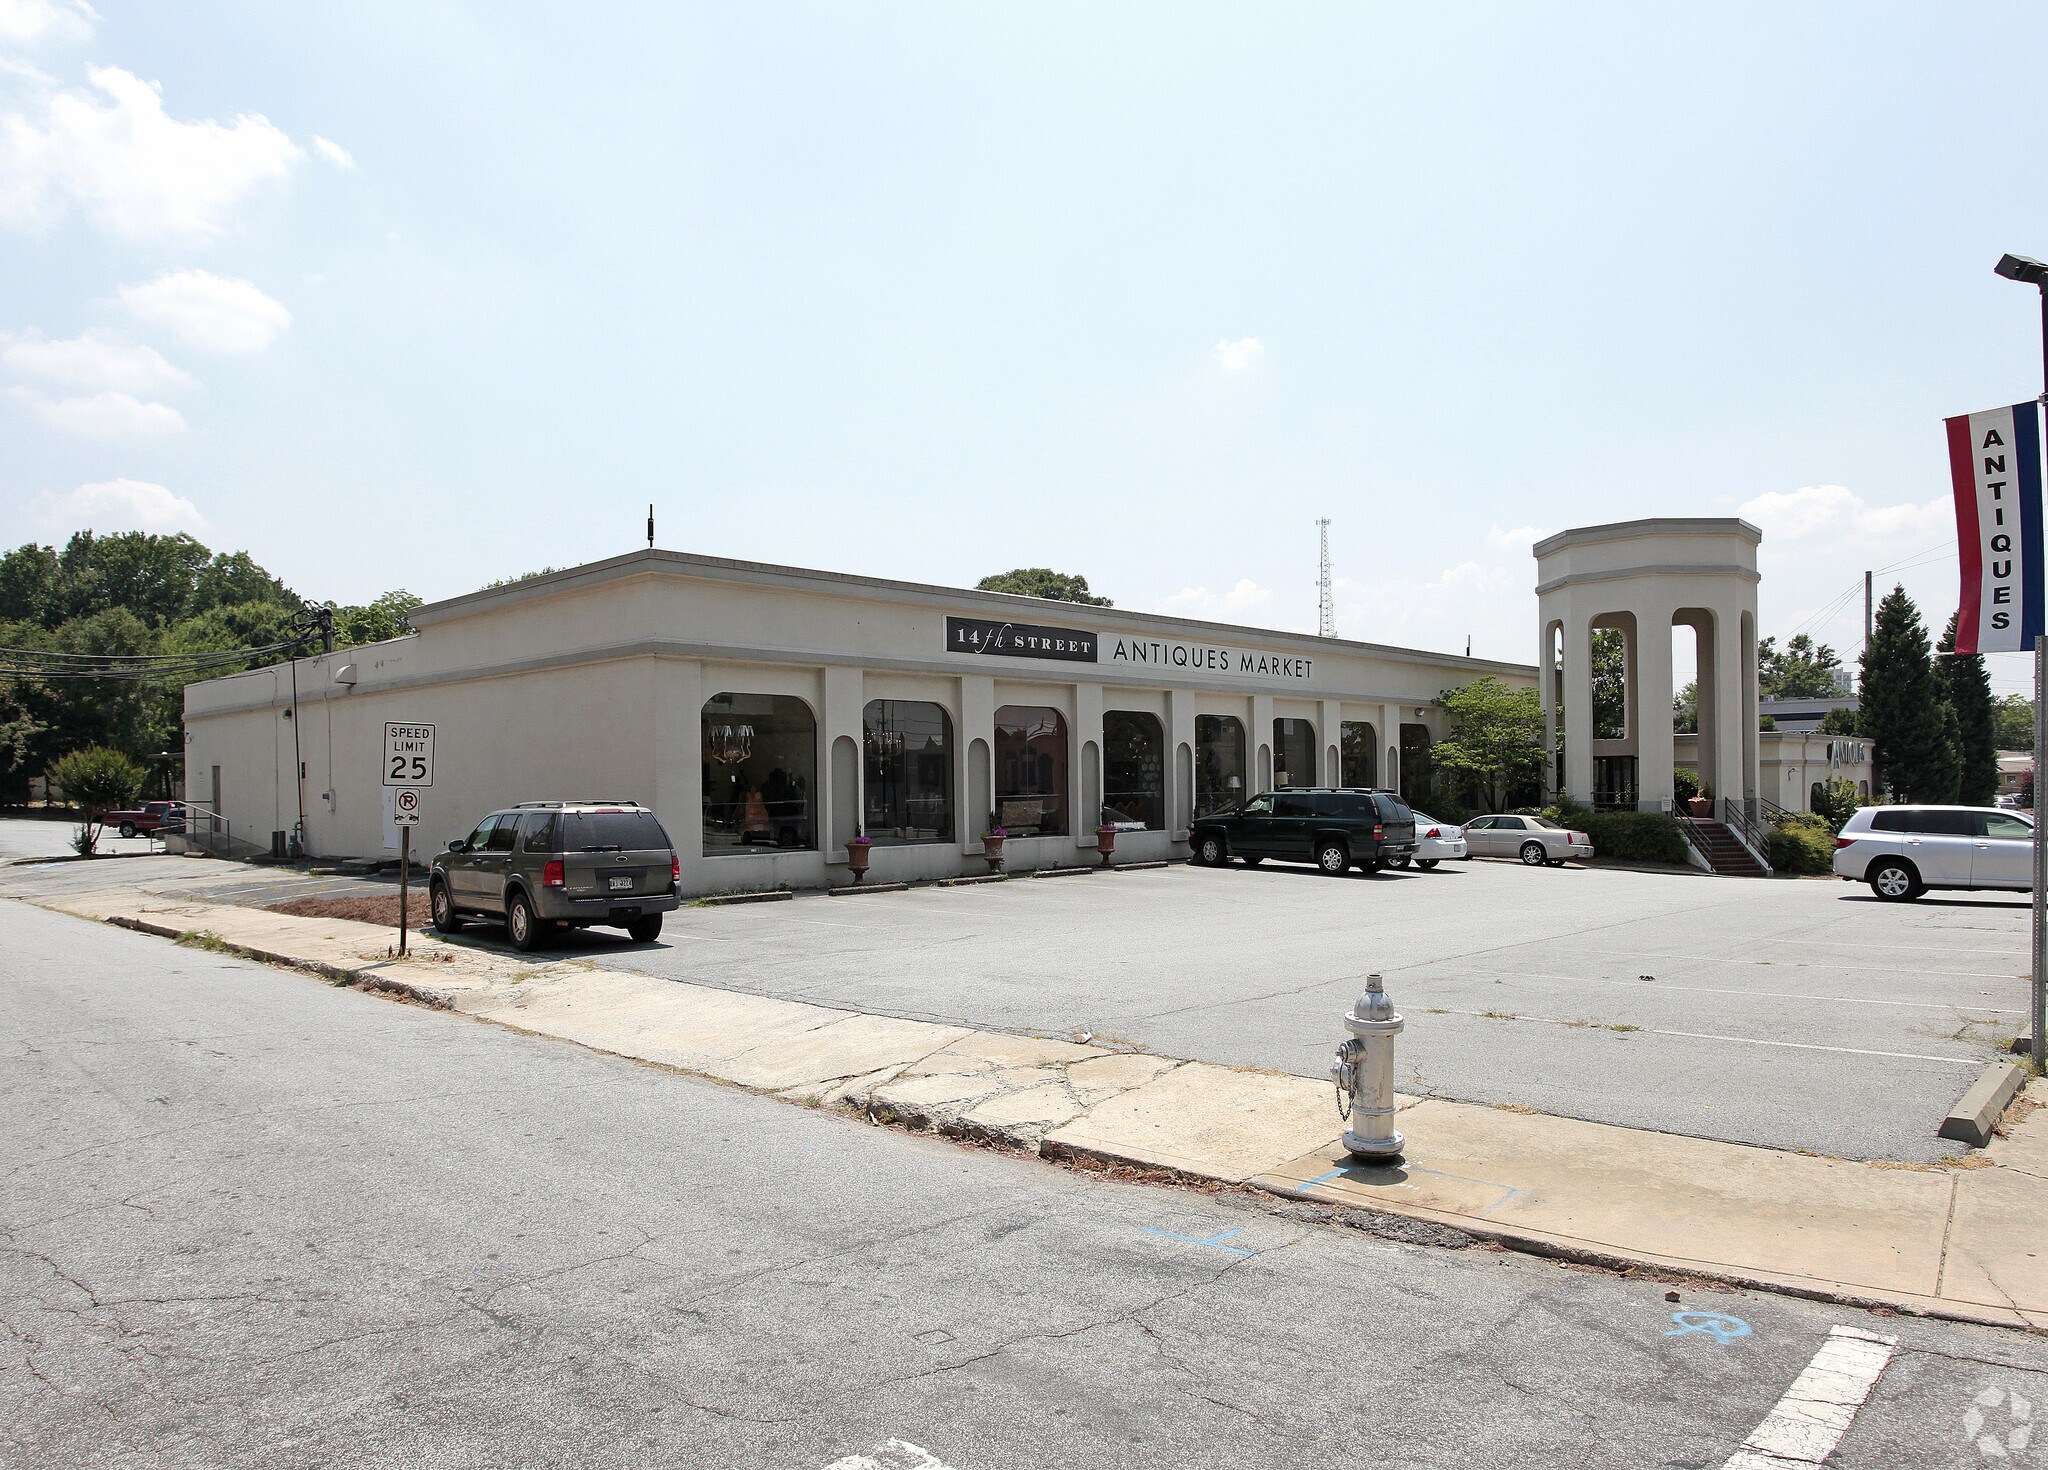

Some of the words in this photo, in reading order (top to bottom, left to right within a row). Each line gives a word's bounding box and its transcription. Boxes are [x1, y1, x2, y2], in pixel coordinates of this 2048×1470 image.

[1982, 429, 2012, 630] ANTIQUES
[957, 623, 1013, 654] 14th
[1014, 635, 1091, 653] STREET
[1113, 638, 1229, 671] ANTIQUES
[1240, 653, 1313, 679] MARKET
[391, 727, 430, 739] SPEED
[394, 741, 425, 752] LIMIT
[390, 756, 427, 780] 25
